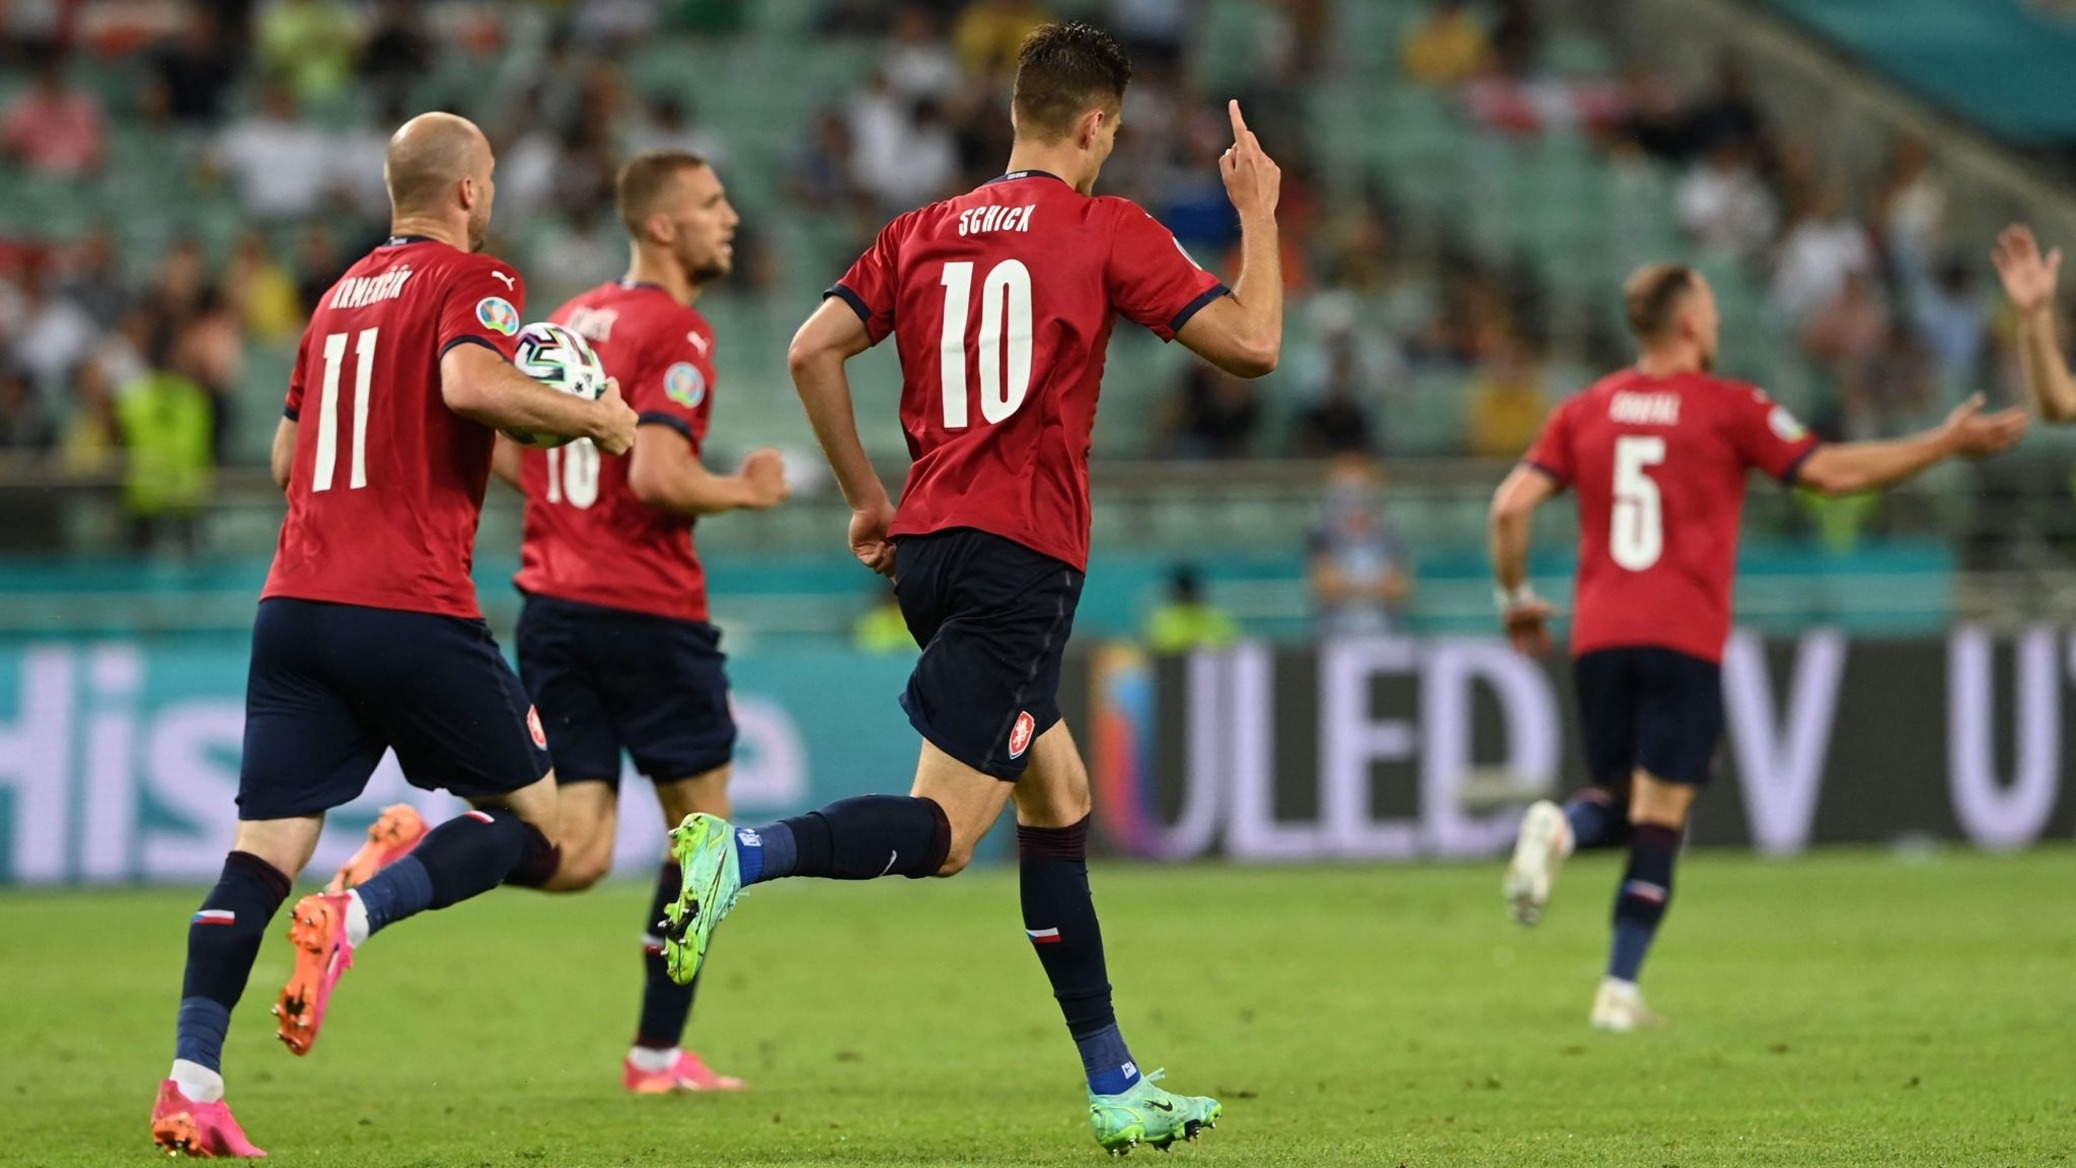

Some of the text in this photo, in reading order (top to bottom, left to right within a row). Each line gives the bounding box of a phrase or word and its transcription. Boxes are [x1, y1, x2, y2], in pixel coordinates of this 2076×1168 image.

[958, 204, 1036, 237] SCHICK
[312, 327, 379, 493] 11
[940, 258, 1034, 429] 10
[1608, 434, 1667, 573] 5
[1089, 621, 2076, 862] ULED V U
